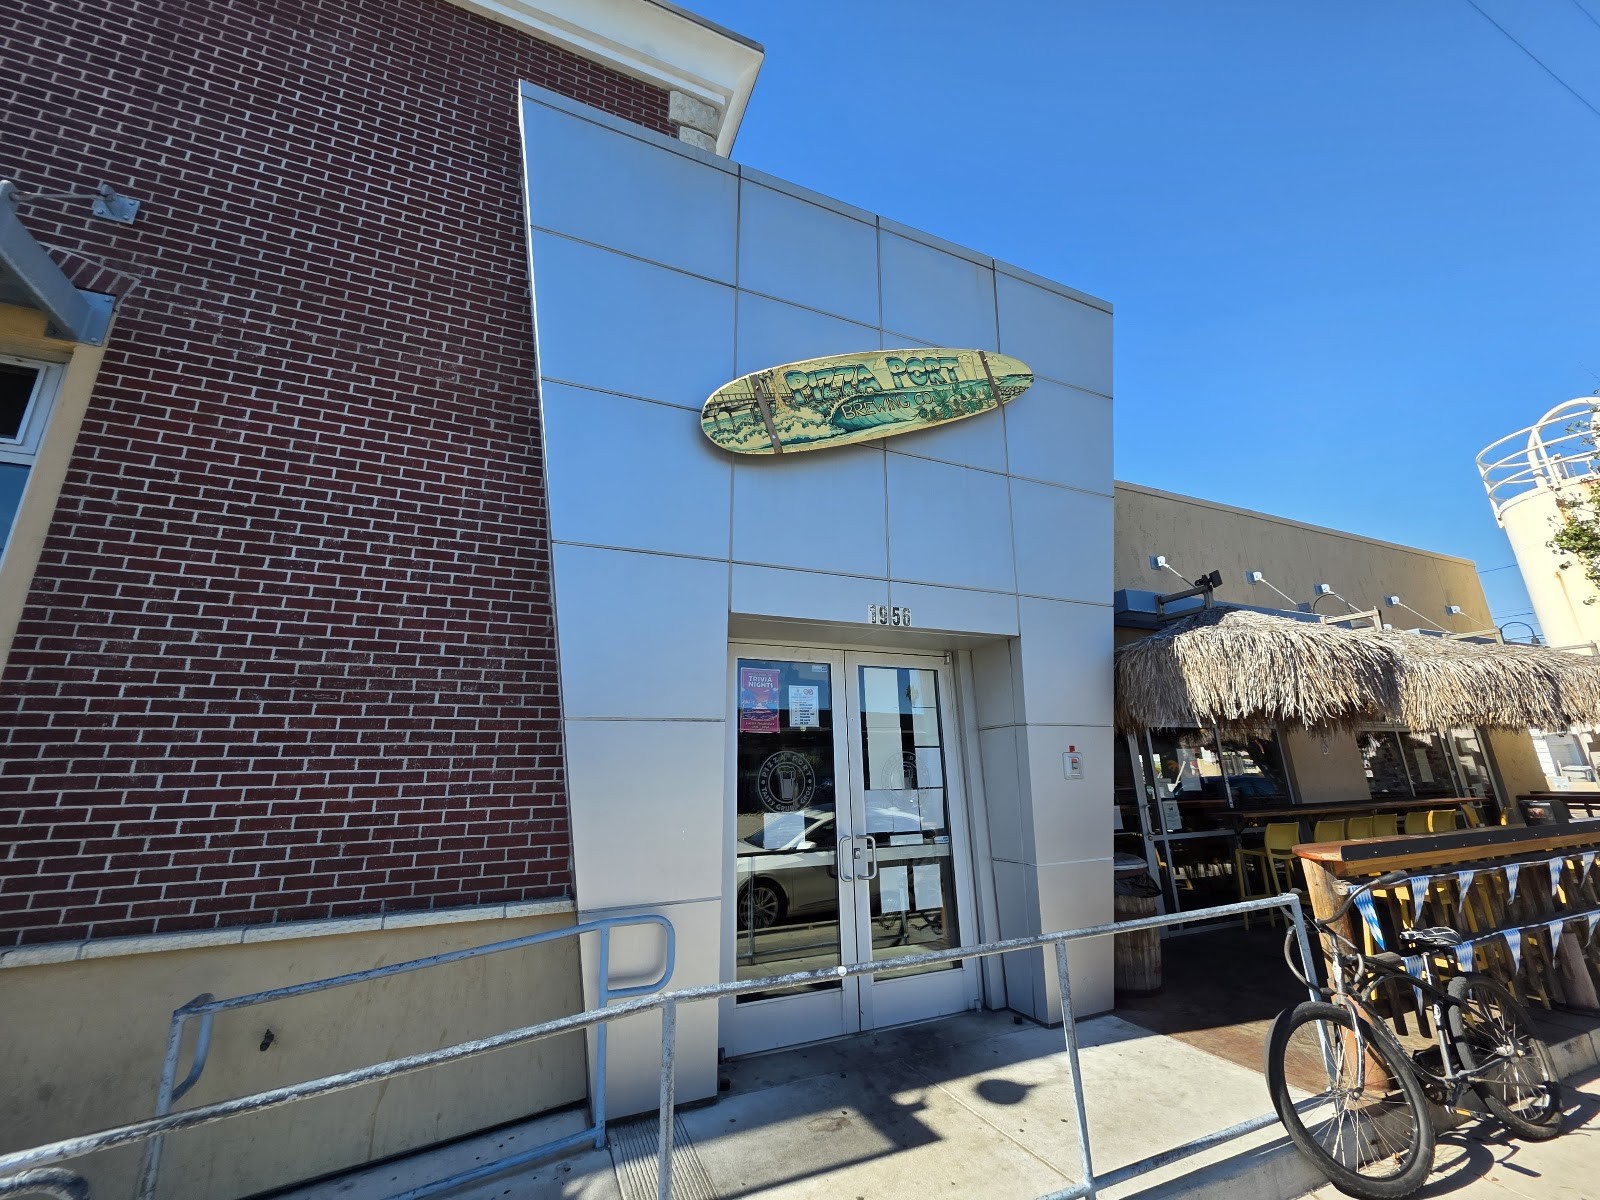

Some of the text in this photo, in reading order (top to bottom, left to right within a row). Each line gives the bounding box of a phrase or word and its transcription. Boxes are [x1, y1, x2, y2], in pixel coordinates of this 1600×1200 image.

[783, 356, 960, 406] PIZZA PORT
[840, 394, 911, 420] BREWING
[869, 604, 911, 627] 1956
[748, 675, 773, 683] TRIVIA
[748, 681, 774, 689] NIGHTS
[761, 753, 812, 778] PIZZA PORT
[761, 786, 776, 806] TASTY
